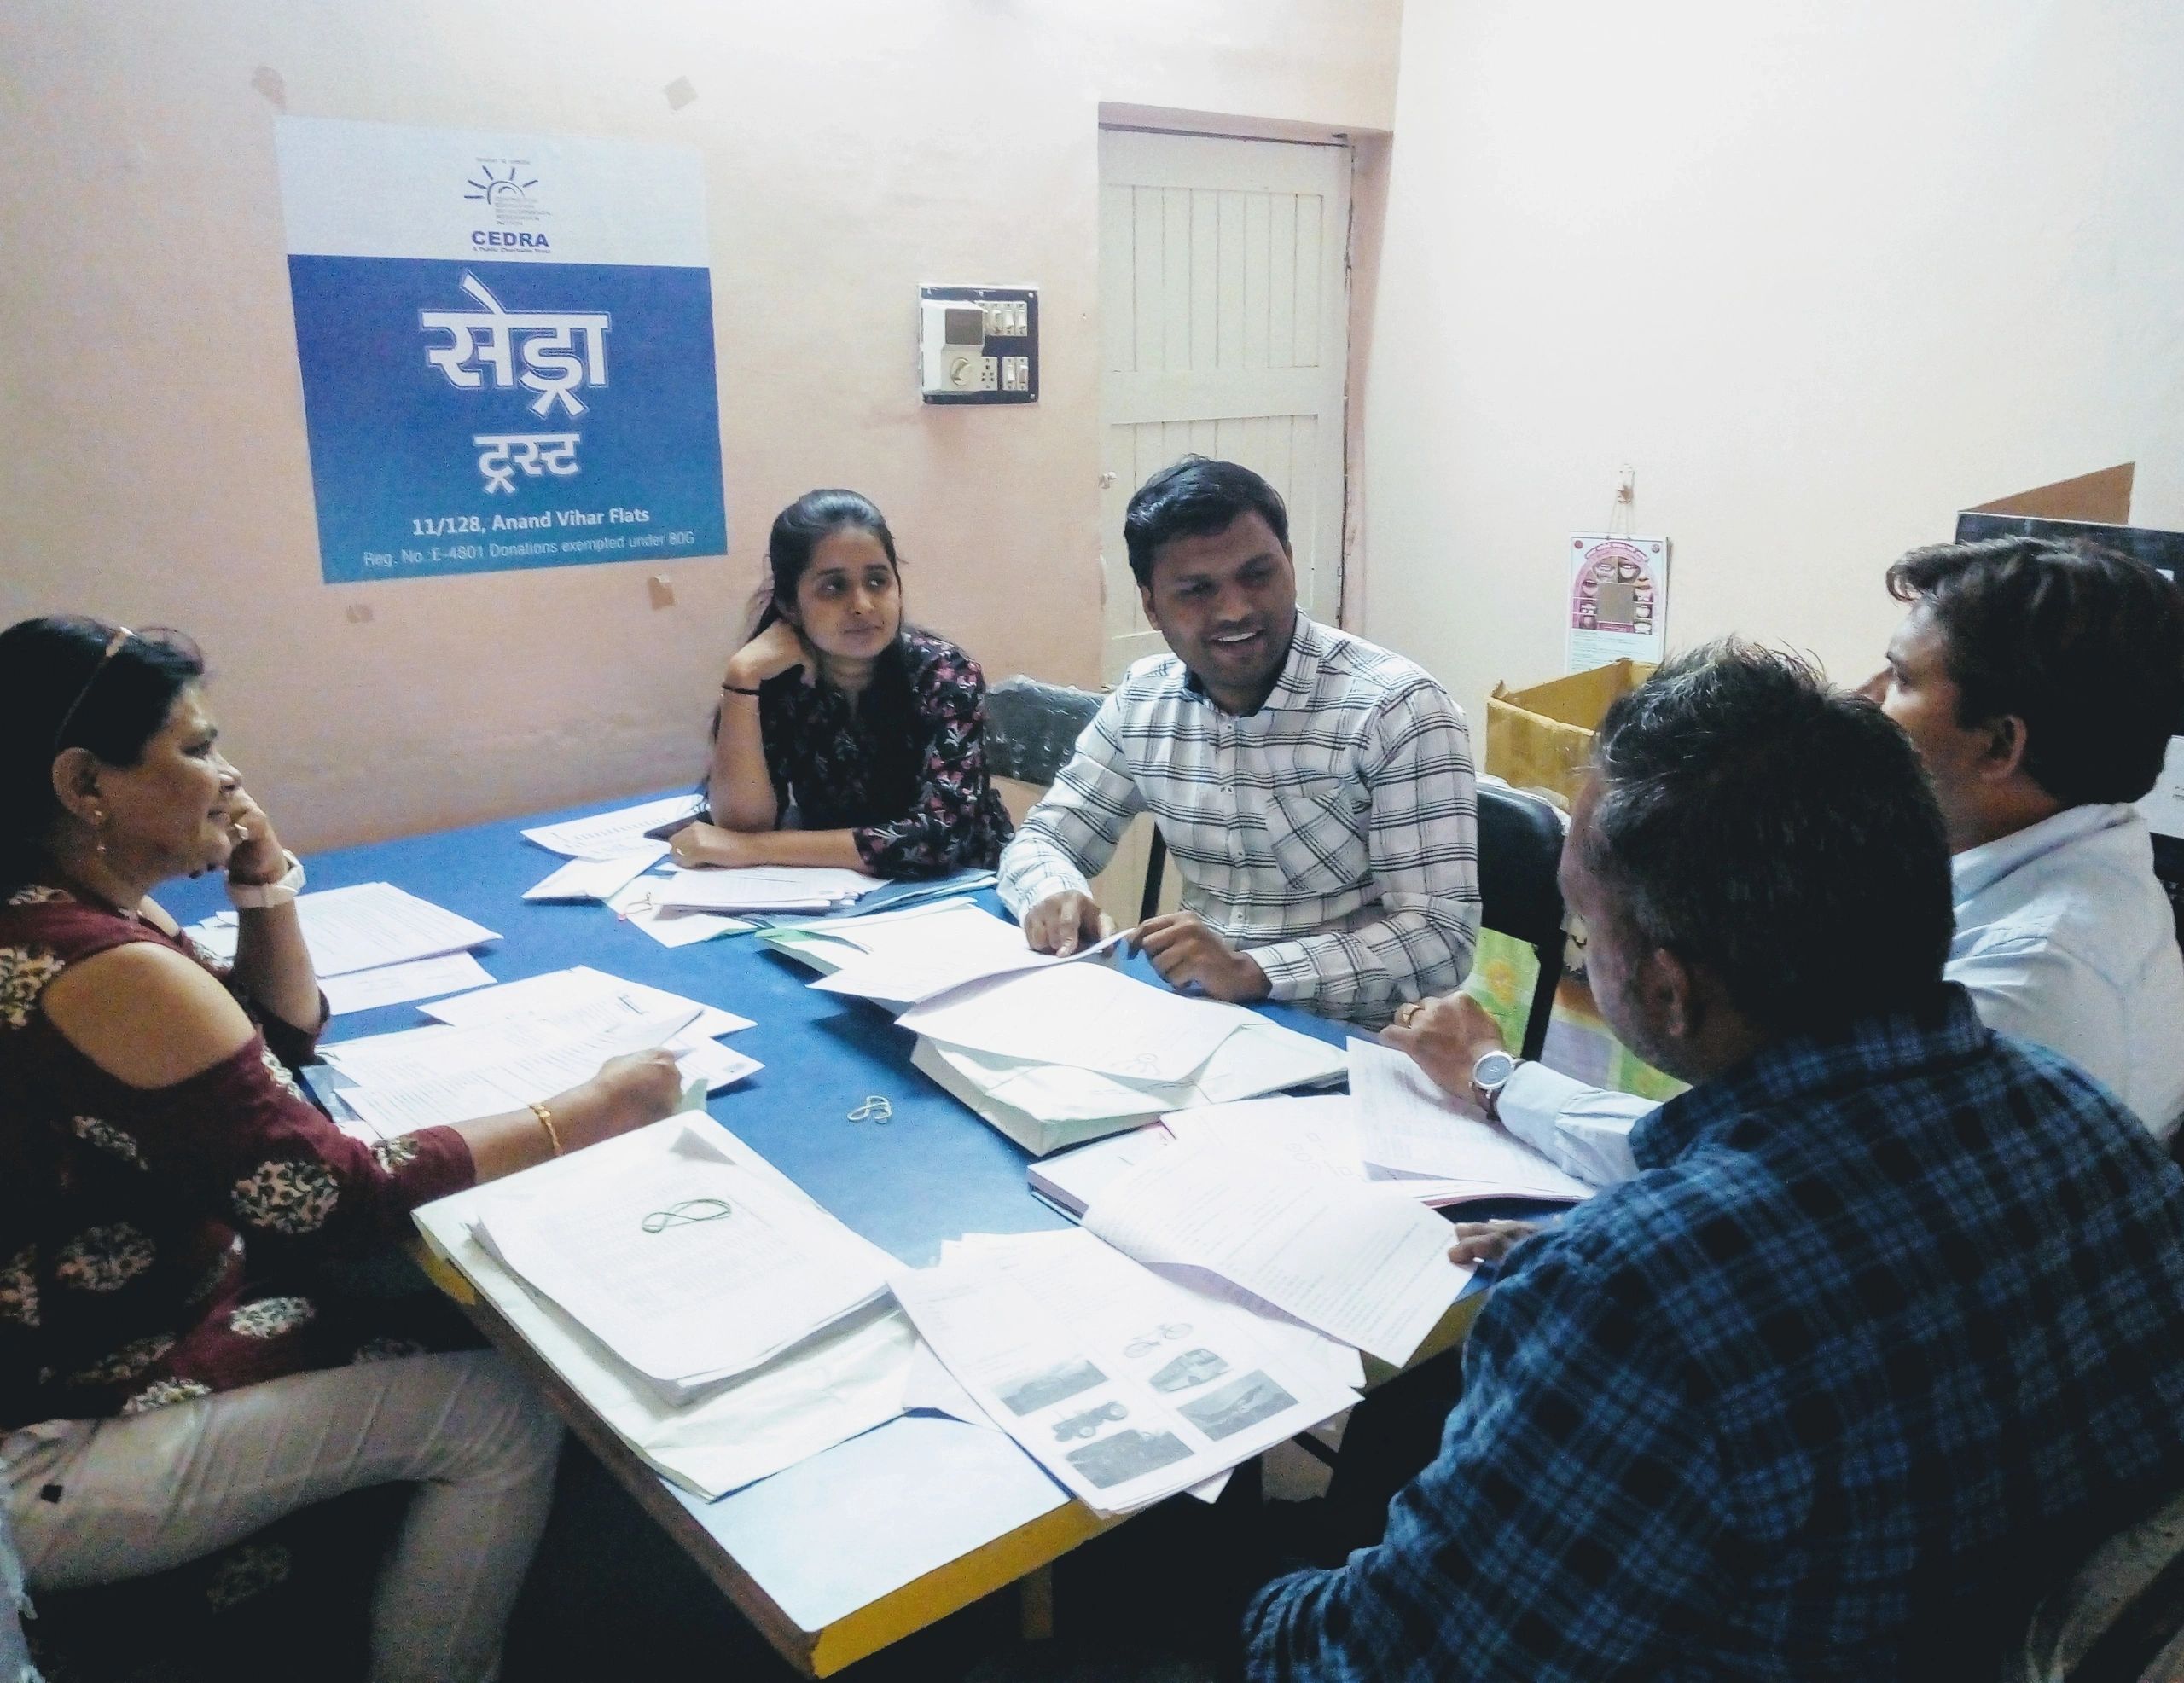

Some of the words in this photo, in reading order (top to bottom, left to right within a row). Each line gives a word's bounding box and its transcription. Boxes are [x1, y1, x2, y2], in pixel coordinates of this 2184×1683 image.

[472, 230, 550, 247] CEDRA
[419, 269, 612, 419] सेड्रा
[473, 432, 581, 495] ट्रस्ट
[412, 515, 486, 537] 11/128,
[492, 511, 552, 531] Anand
[555, 509, 605, 527] Vihar
[609, 508, 650, 524] Flats
[489, 541, 559, 558] Donations
[561, 536, 625, 552] exempted
[629, 534, 665, 548] under
